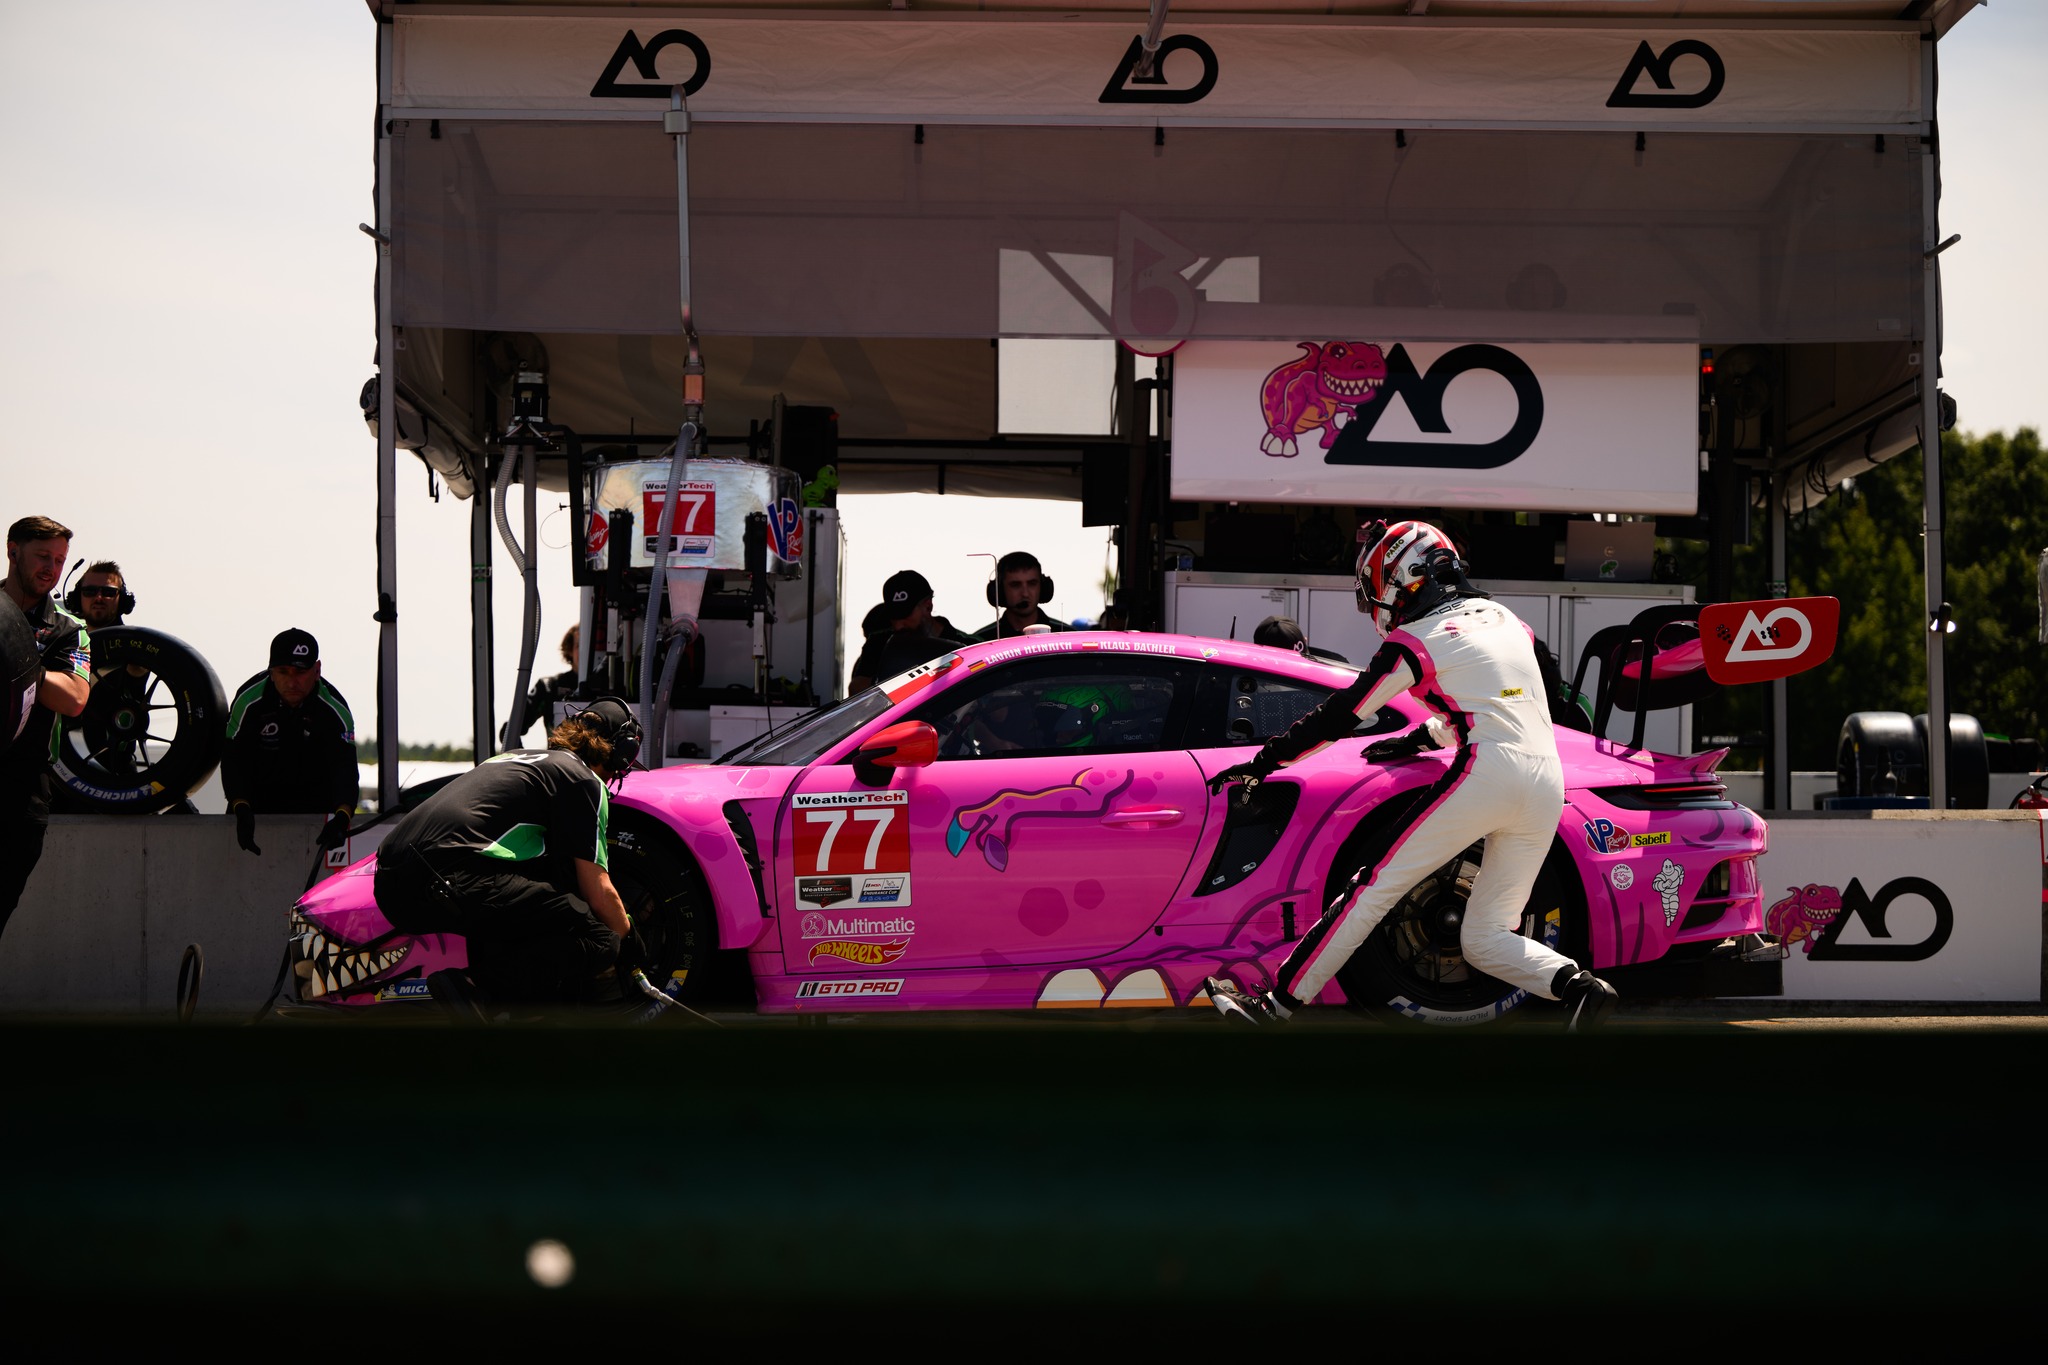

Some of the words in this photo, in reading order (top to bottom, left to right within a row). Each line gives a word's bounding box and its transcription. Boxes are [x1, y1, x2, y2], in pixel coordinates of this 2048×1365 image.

[1607, 39, 1726, 108] AO
[1324, 343, 1544, 469] AO
[645, 482, 713, 490] WeaerTech
[985, 647, 1021, 665] LAURIN
[1024, 641, 1073, 654] HEINRICH
[1100, 641, 1131, 651] KLAUS
[1133, 642, 1176, 654] BACHLER
[73, 780, 139, 800] MICHELIN
[797, 792, 903, 805] WeatherTech
[806, 808, 895, 872] 77
[1635, 832, 1667, 846] Sabelt
[1807, 877, 1953, 961] AO
[827, 917, 915, 936] Multimatic
[815, 944, 832, 955] HOT
[399, 984, 430, 994] MICH
[818, 984, 859, 995] GTD
[860, 982, 900, 993] PRO
[1464, 1010, 1489, 1021] PILOT
